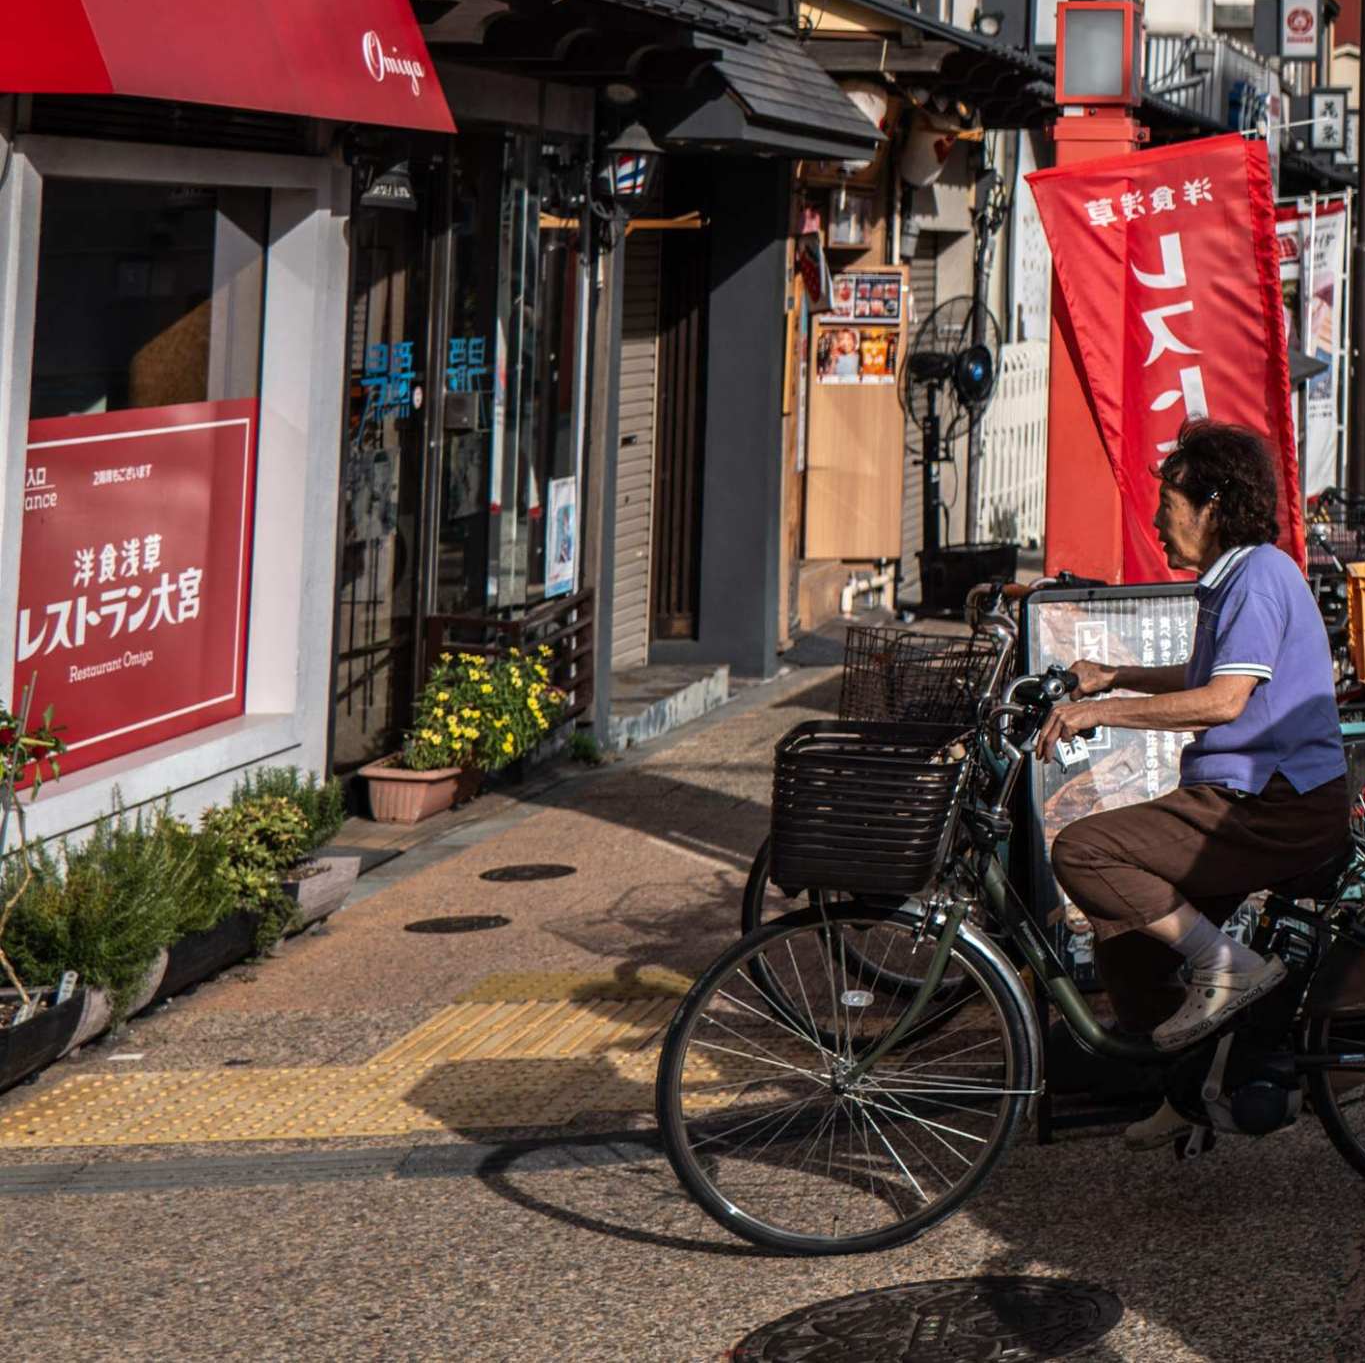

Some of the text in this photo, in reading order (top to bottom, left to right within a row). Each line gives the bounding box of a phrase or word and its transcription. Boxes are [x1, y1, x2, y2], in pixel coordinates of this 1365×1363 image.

[361, 29, 426, 97] Omiya
[73, 533, 162, 587] 洋食浅草
[17, 567, 203, 663] レストラン大宮
[69, 649, 154, 683] Restaurant Omiya
